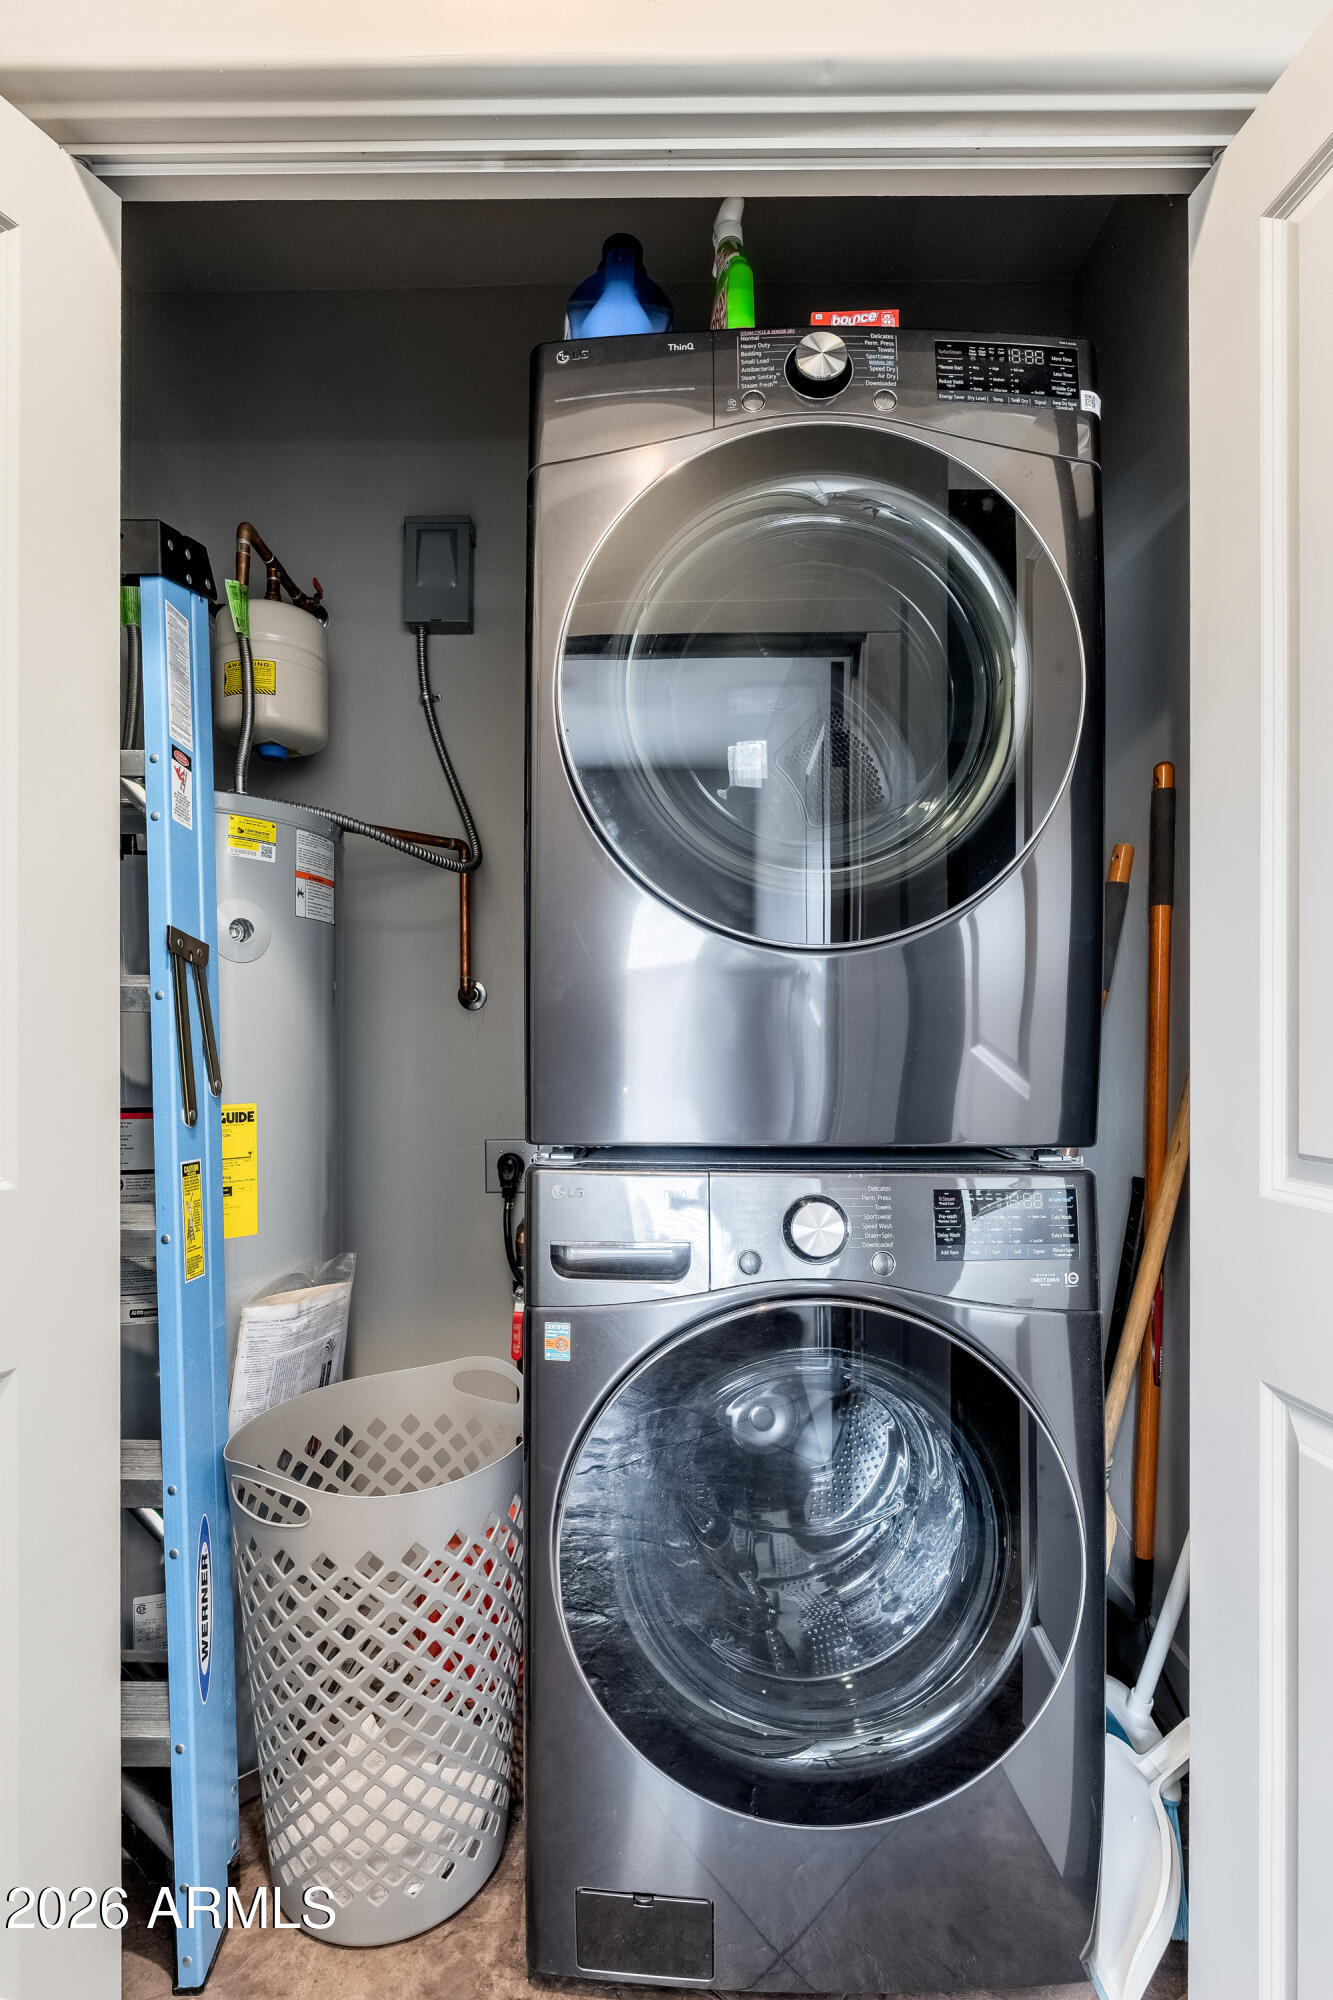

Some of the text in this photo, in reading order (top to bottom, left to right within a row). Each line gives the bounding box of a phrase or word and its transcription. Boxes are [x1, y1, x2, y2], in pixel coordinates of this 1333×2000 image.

[832, 312, 878, 326] bounce
[667, 342, 695, 352] ThinQ
[568, 1187, 584, 1198] LG
[1064, 1272, 1079, 1284] 10
[201, 1553, 209, 1662] WERNER
